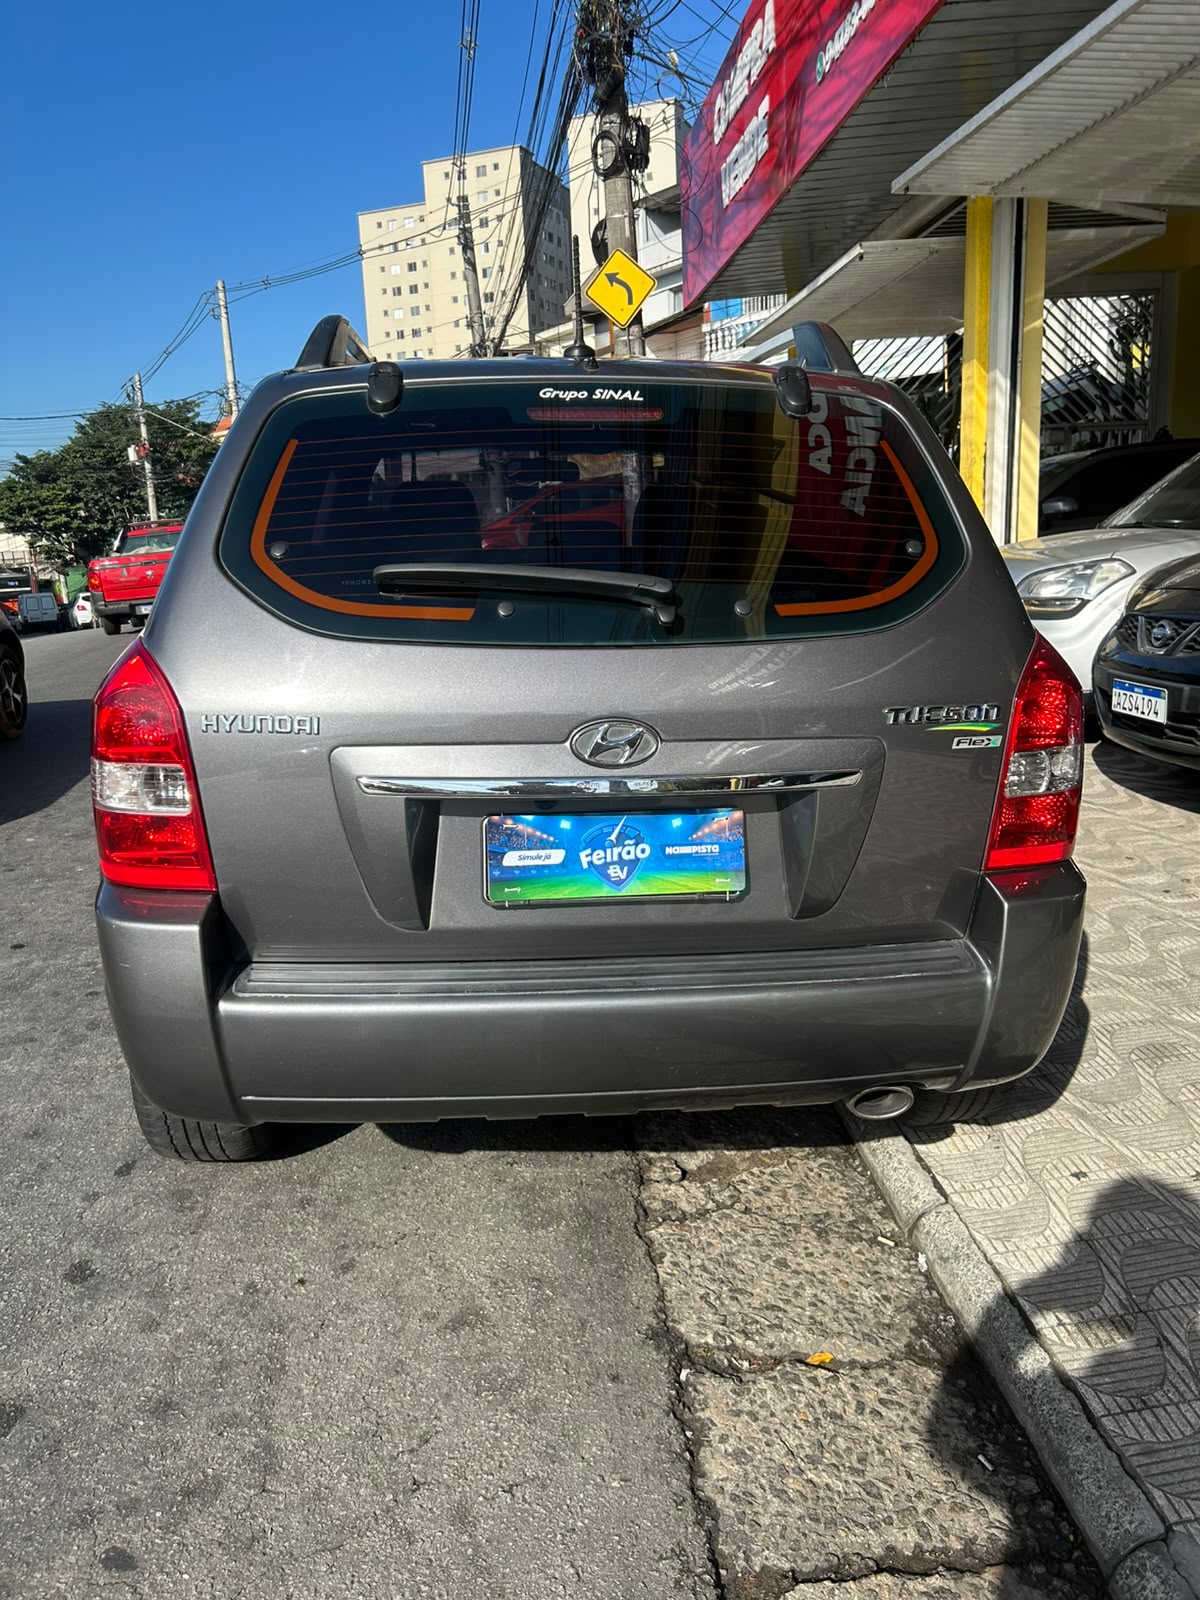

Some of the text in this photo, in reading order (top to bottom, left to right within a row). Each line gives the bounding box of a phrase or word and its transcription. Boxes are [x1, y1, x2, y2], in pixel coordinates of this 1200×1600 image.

[721, 94, 770, 210] VENDE
[539, 387, 644, 401] Grupo SINAL
[200, 714, 320, 735] HYUNDAI
[882, 703, 1000, 725] TUCSON
[517, 853, 552, 862] Simule já
[579, 839, 651, 870] Feirão
